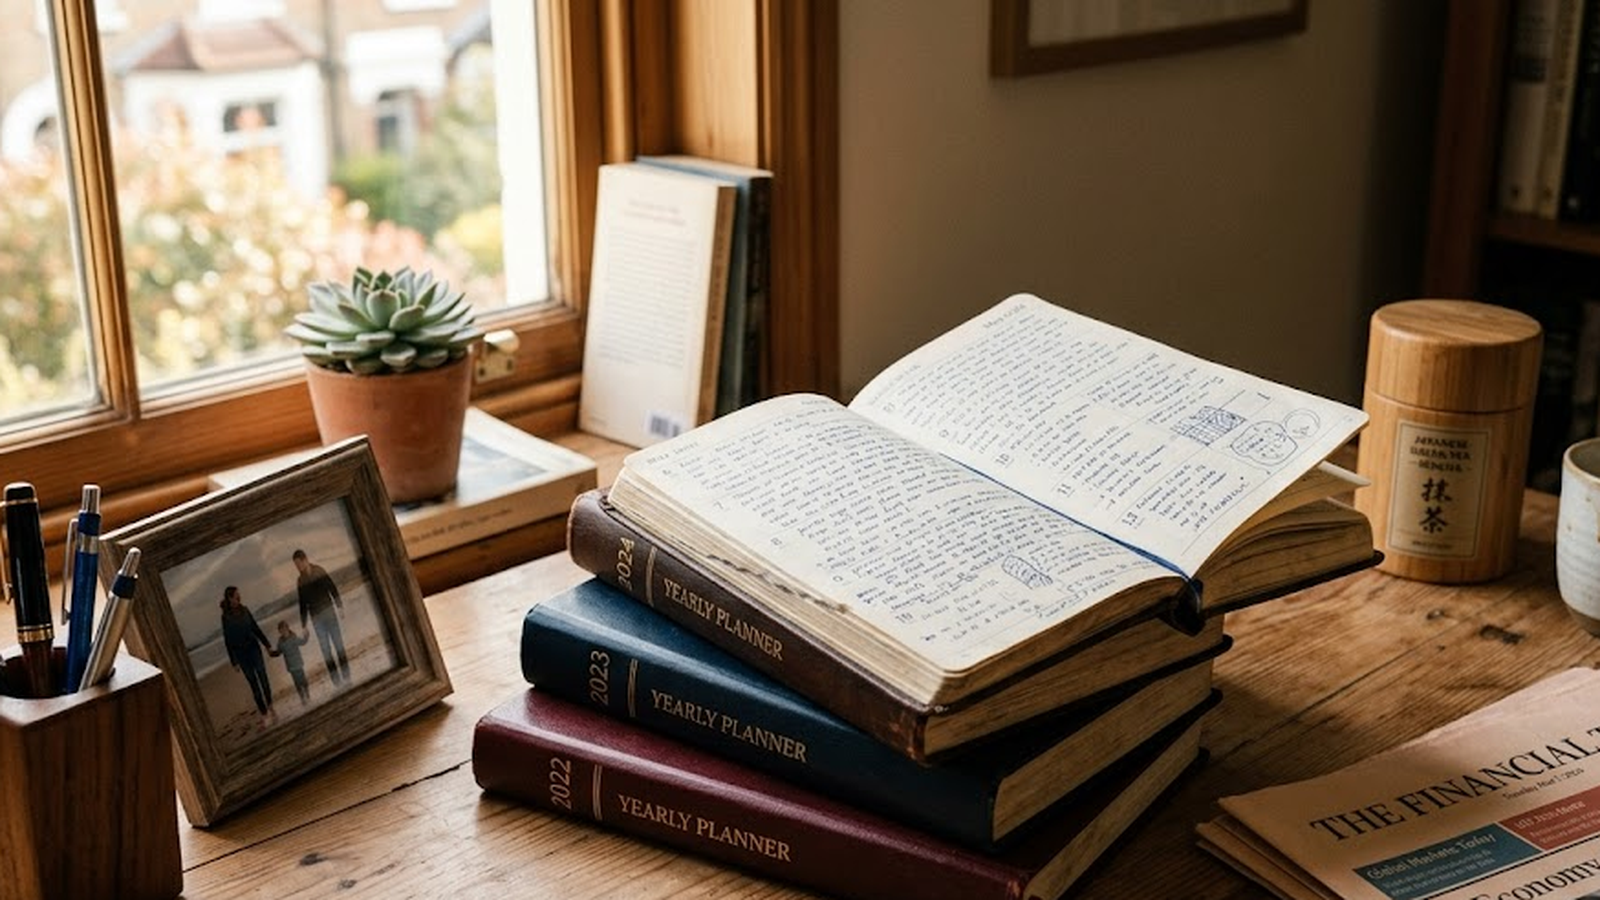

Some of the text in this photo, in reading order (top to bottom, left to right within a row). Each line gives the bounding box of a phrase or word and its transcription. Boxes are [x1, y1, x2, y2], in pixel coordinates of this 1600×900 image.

[617, 537, 635, 592] 2024
[663, 577, 783, 661] YEARLY PLANNER
[589, 650, 610, 706] 2023
[651, 688, 807, 764] YEARLY PLANNER
[550, 757, 572, 810] 2022
[1309, 802, 1407, 841] THE
[1394, 738, 1600, 816] FINANCIAL
[617, 794, 792, 862] YEARLY PLANNER
